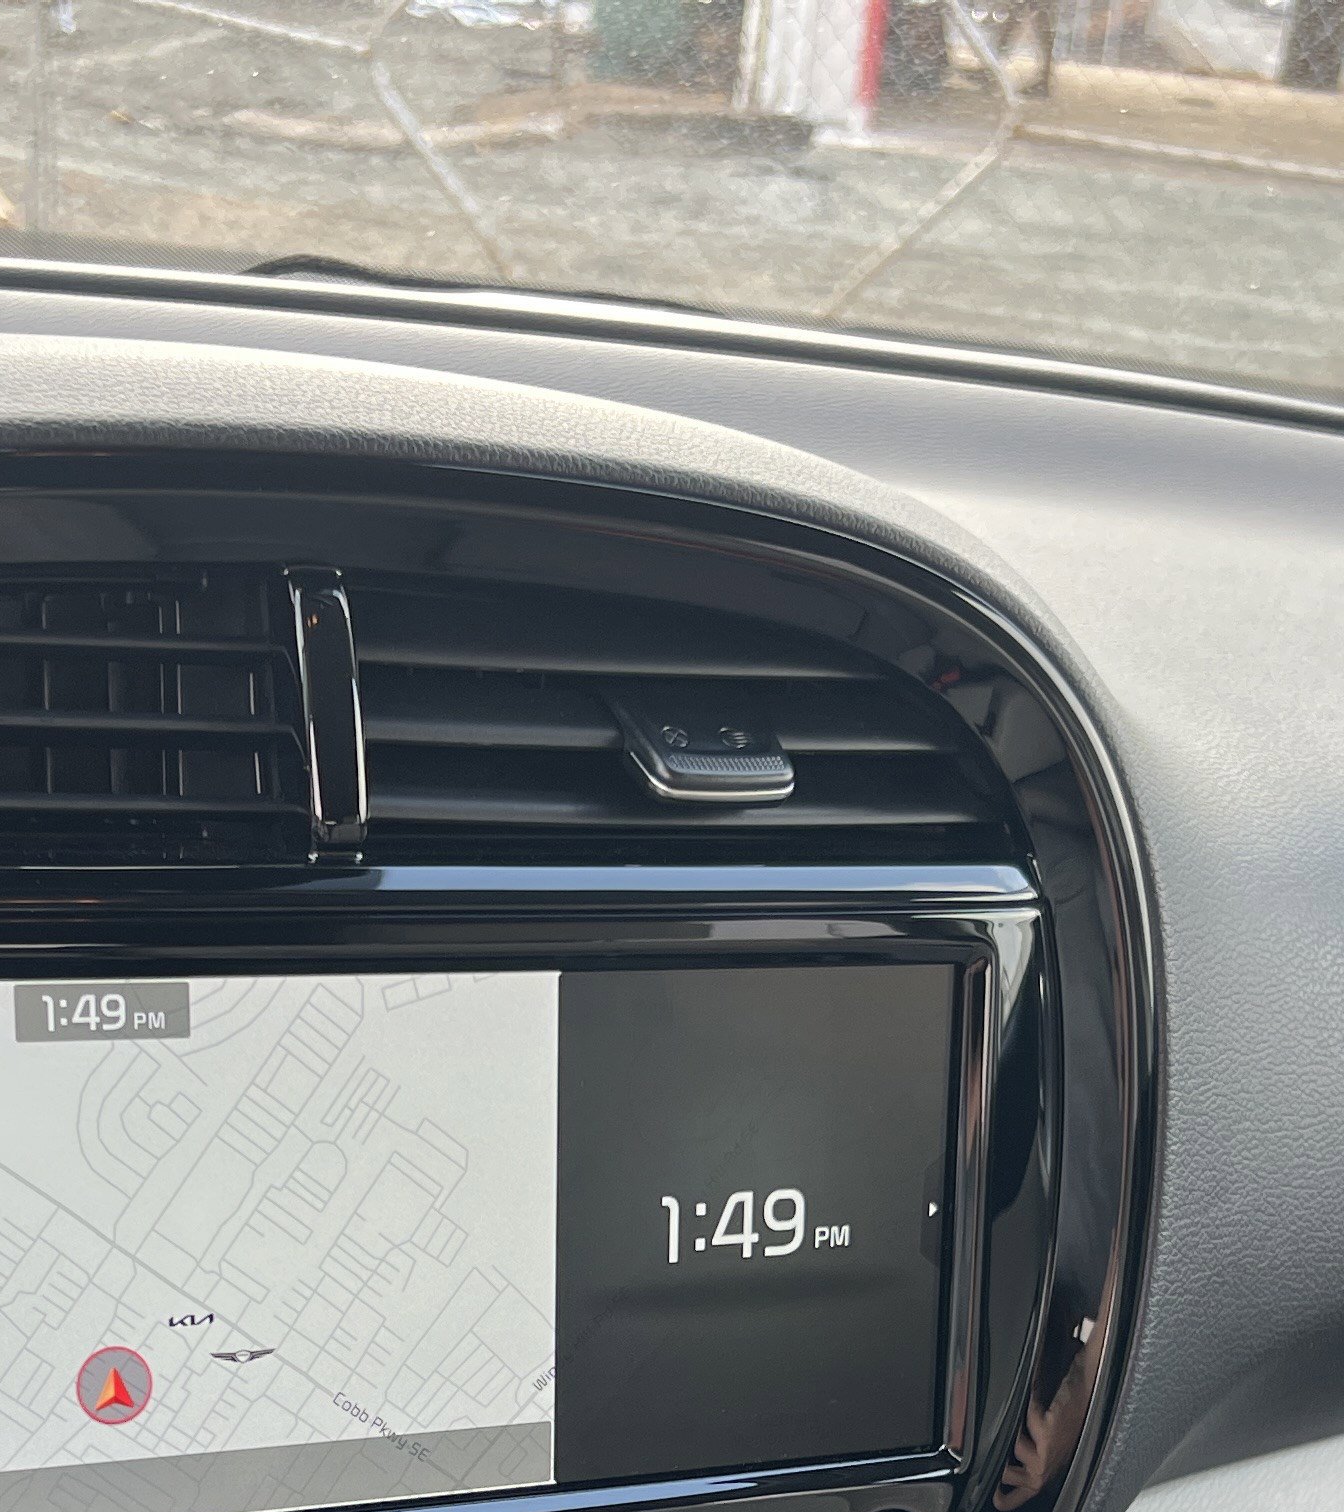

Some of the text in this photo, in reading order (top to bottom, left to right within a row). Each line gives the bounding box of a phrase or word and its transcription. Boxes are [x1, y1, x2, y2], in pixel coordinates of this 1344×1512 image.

[41, 992, 166, 1032] 1:49 PM
[661, 1188, 851, 1263] 1:49 PM
[332, 1390, 432, 1464] Cobb Pkwy SE
